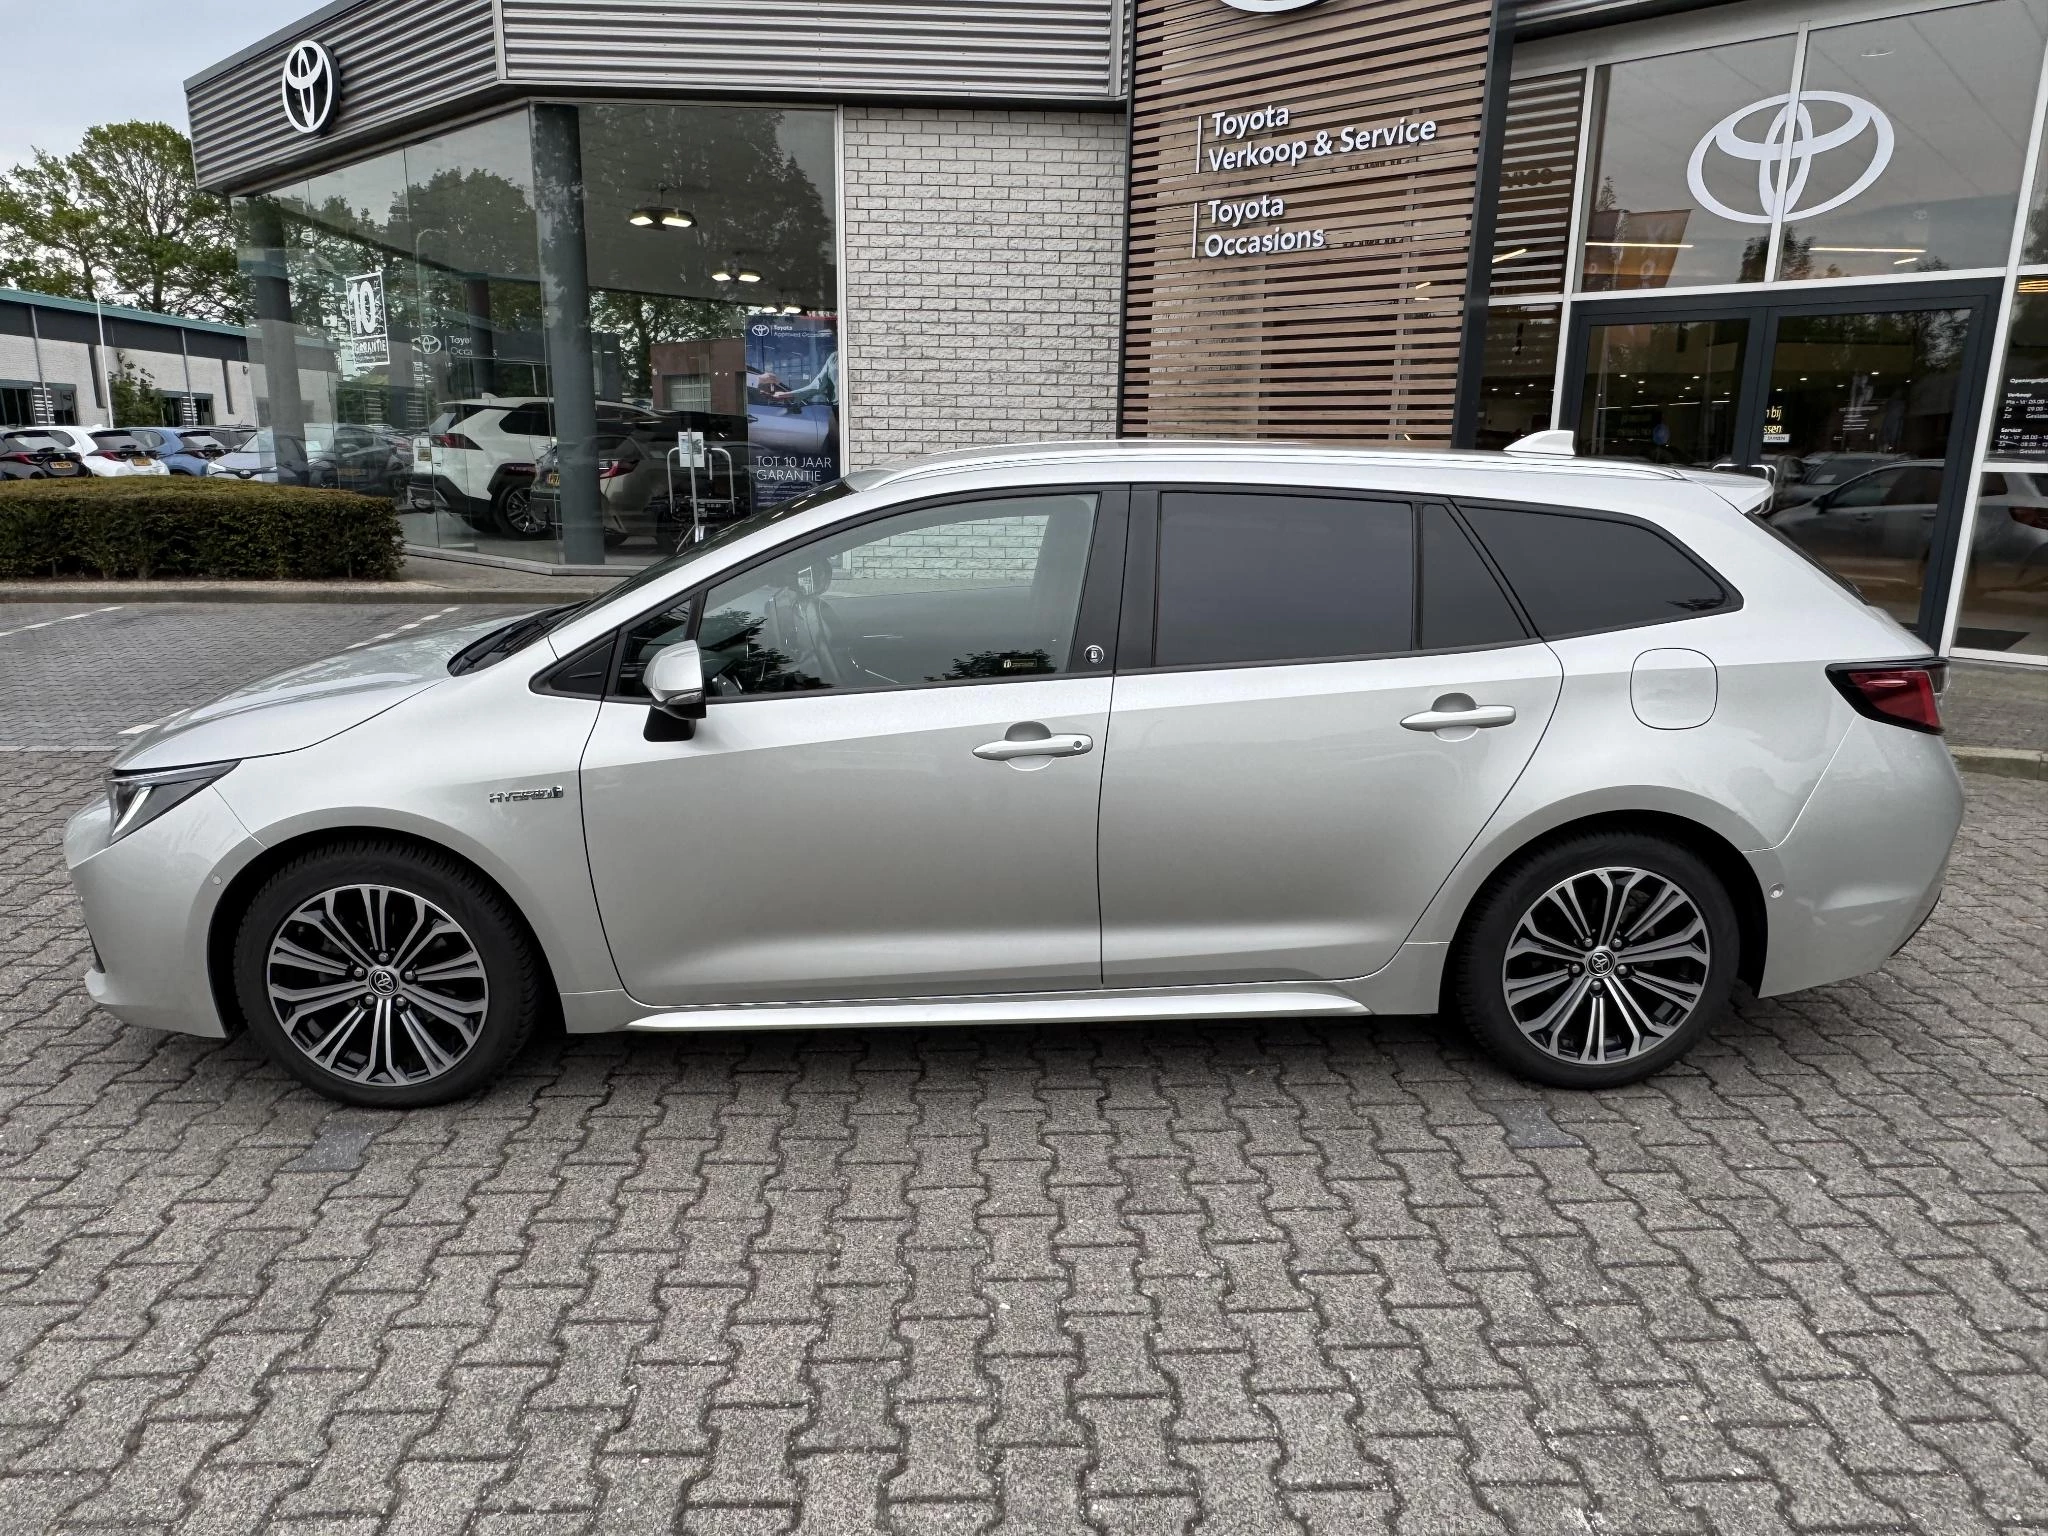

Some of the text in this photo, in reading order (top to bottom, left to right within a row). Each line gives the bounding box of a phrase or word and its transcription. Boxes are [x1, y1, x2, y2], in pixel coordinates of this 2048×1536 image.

[1212, 105, 1290, 139] Toyota
[1208, 117, 1437, 171] Verkoop & Service
[1208, 194, 1284, 227] Toyota
[1204, 227, 1325, 257] Occasions
[349, 281, 376, 334] 10
[755, 455, 832, 469] TOT 10 JAAR
[756, 469, 822, 482] GARANTIE
[489, 788, 553, 803] HYBRID
